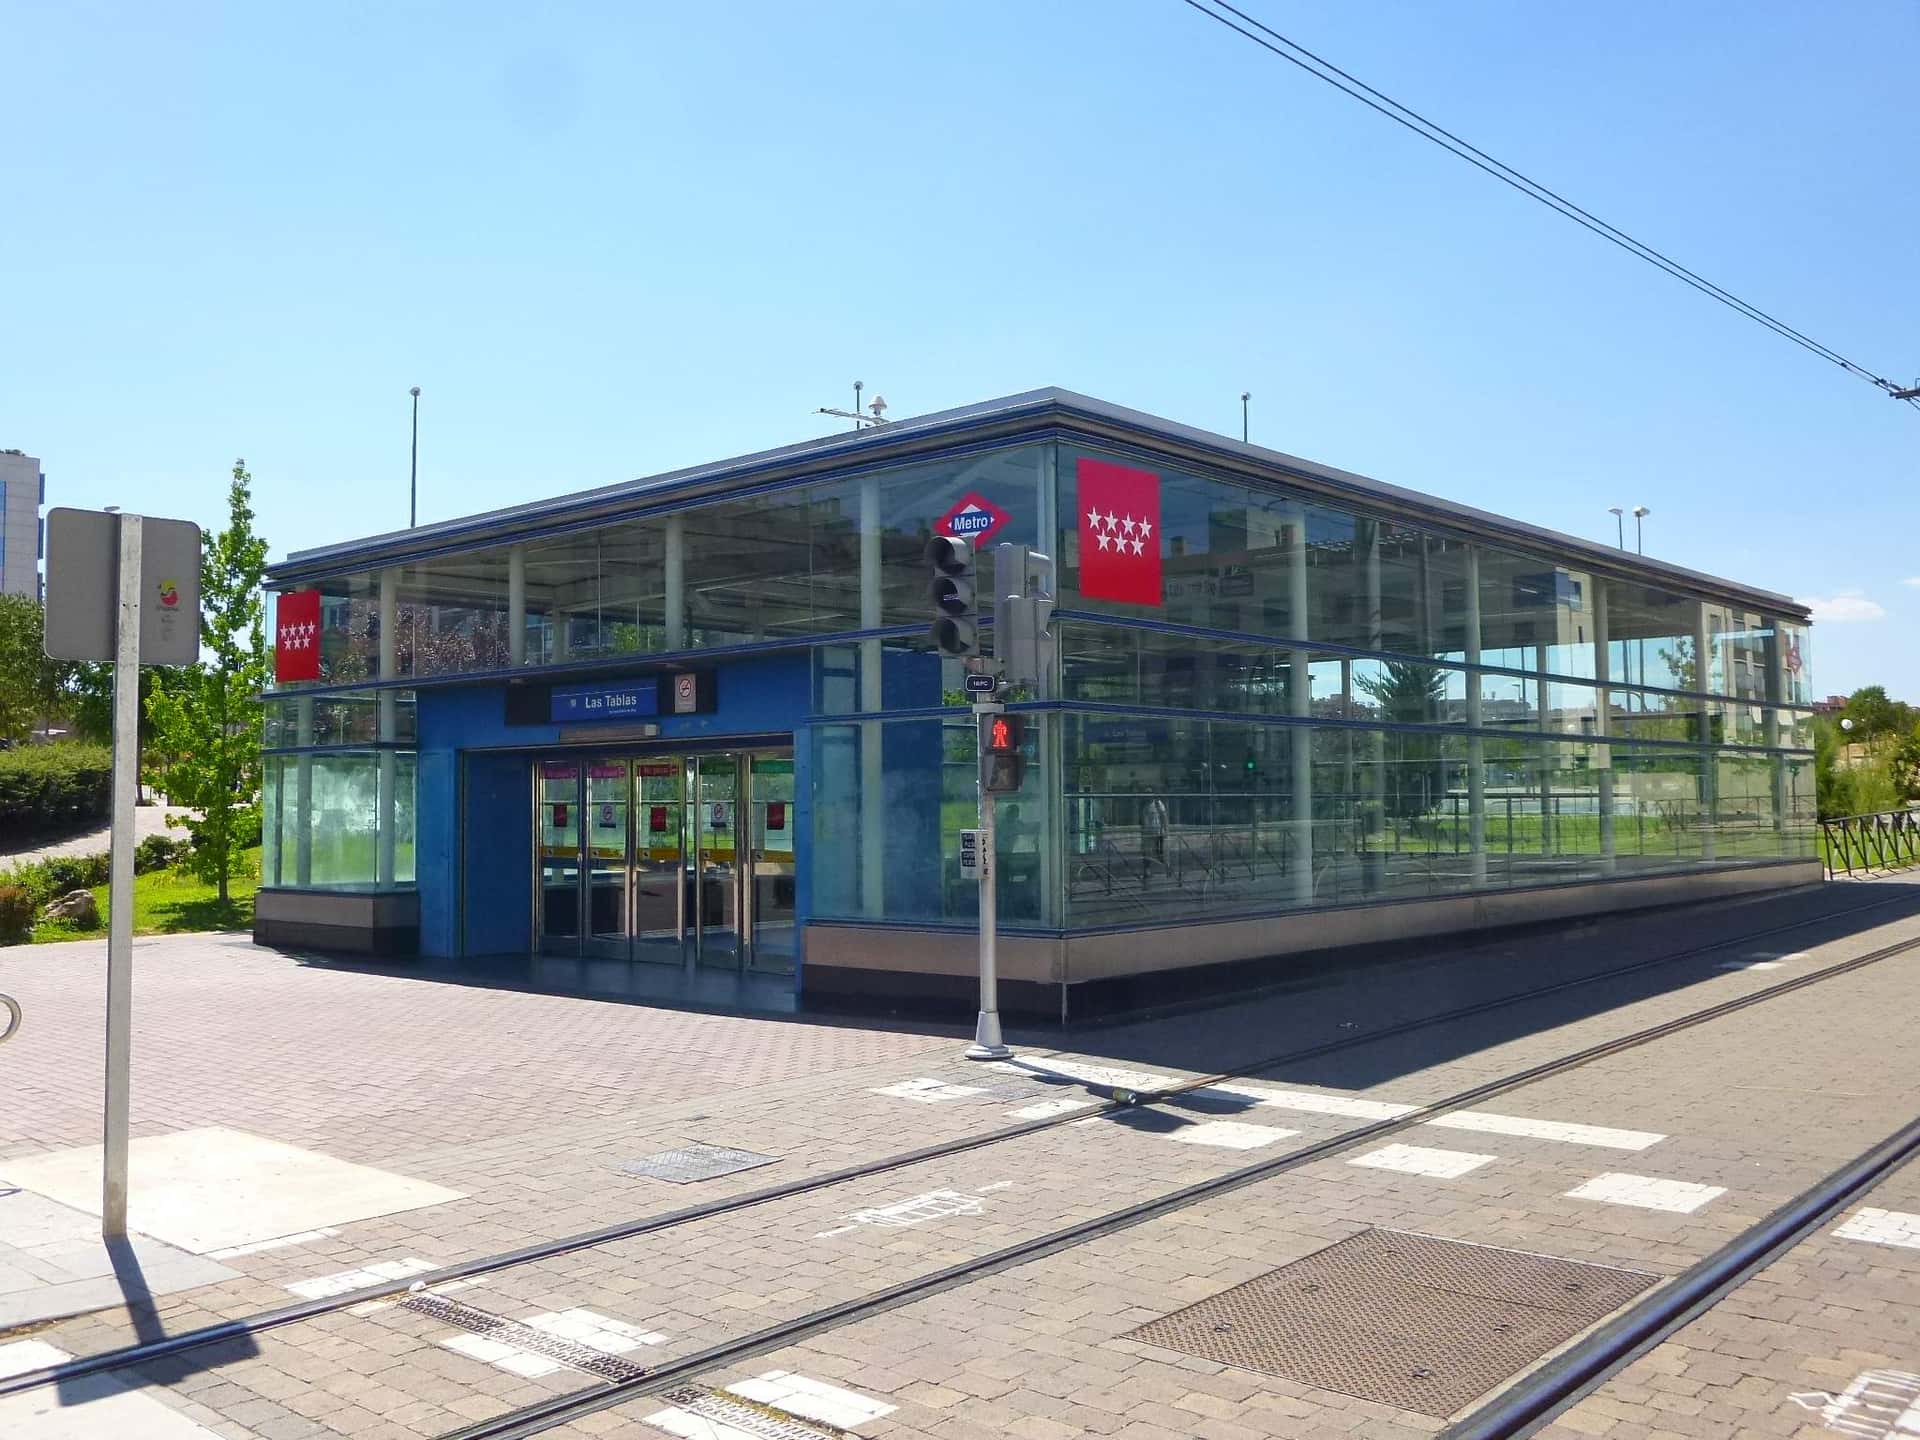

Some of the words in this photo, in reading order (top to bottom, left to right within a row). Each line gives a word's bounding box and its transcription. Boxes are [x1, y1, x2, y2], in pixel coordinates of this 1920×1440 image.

[954, 516, 988, 531] Metro
[585, 697, 602, 709] Las
[605, 694, 637, 708] Tablas
